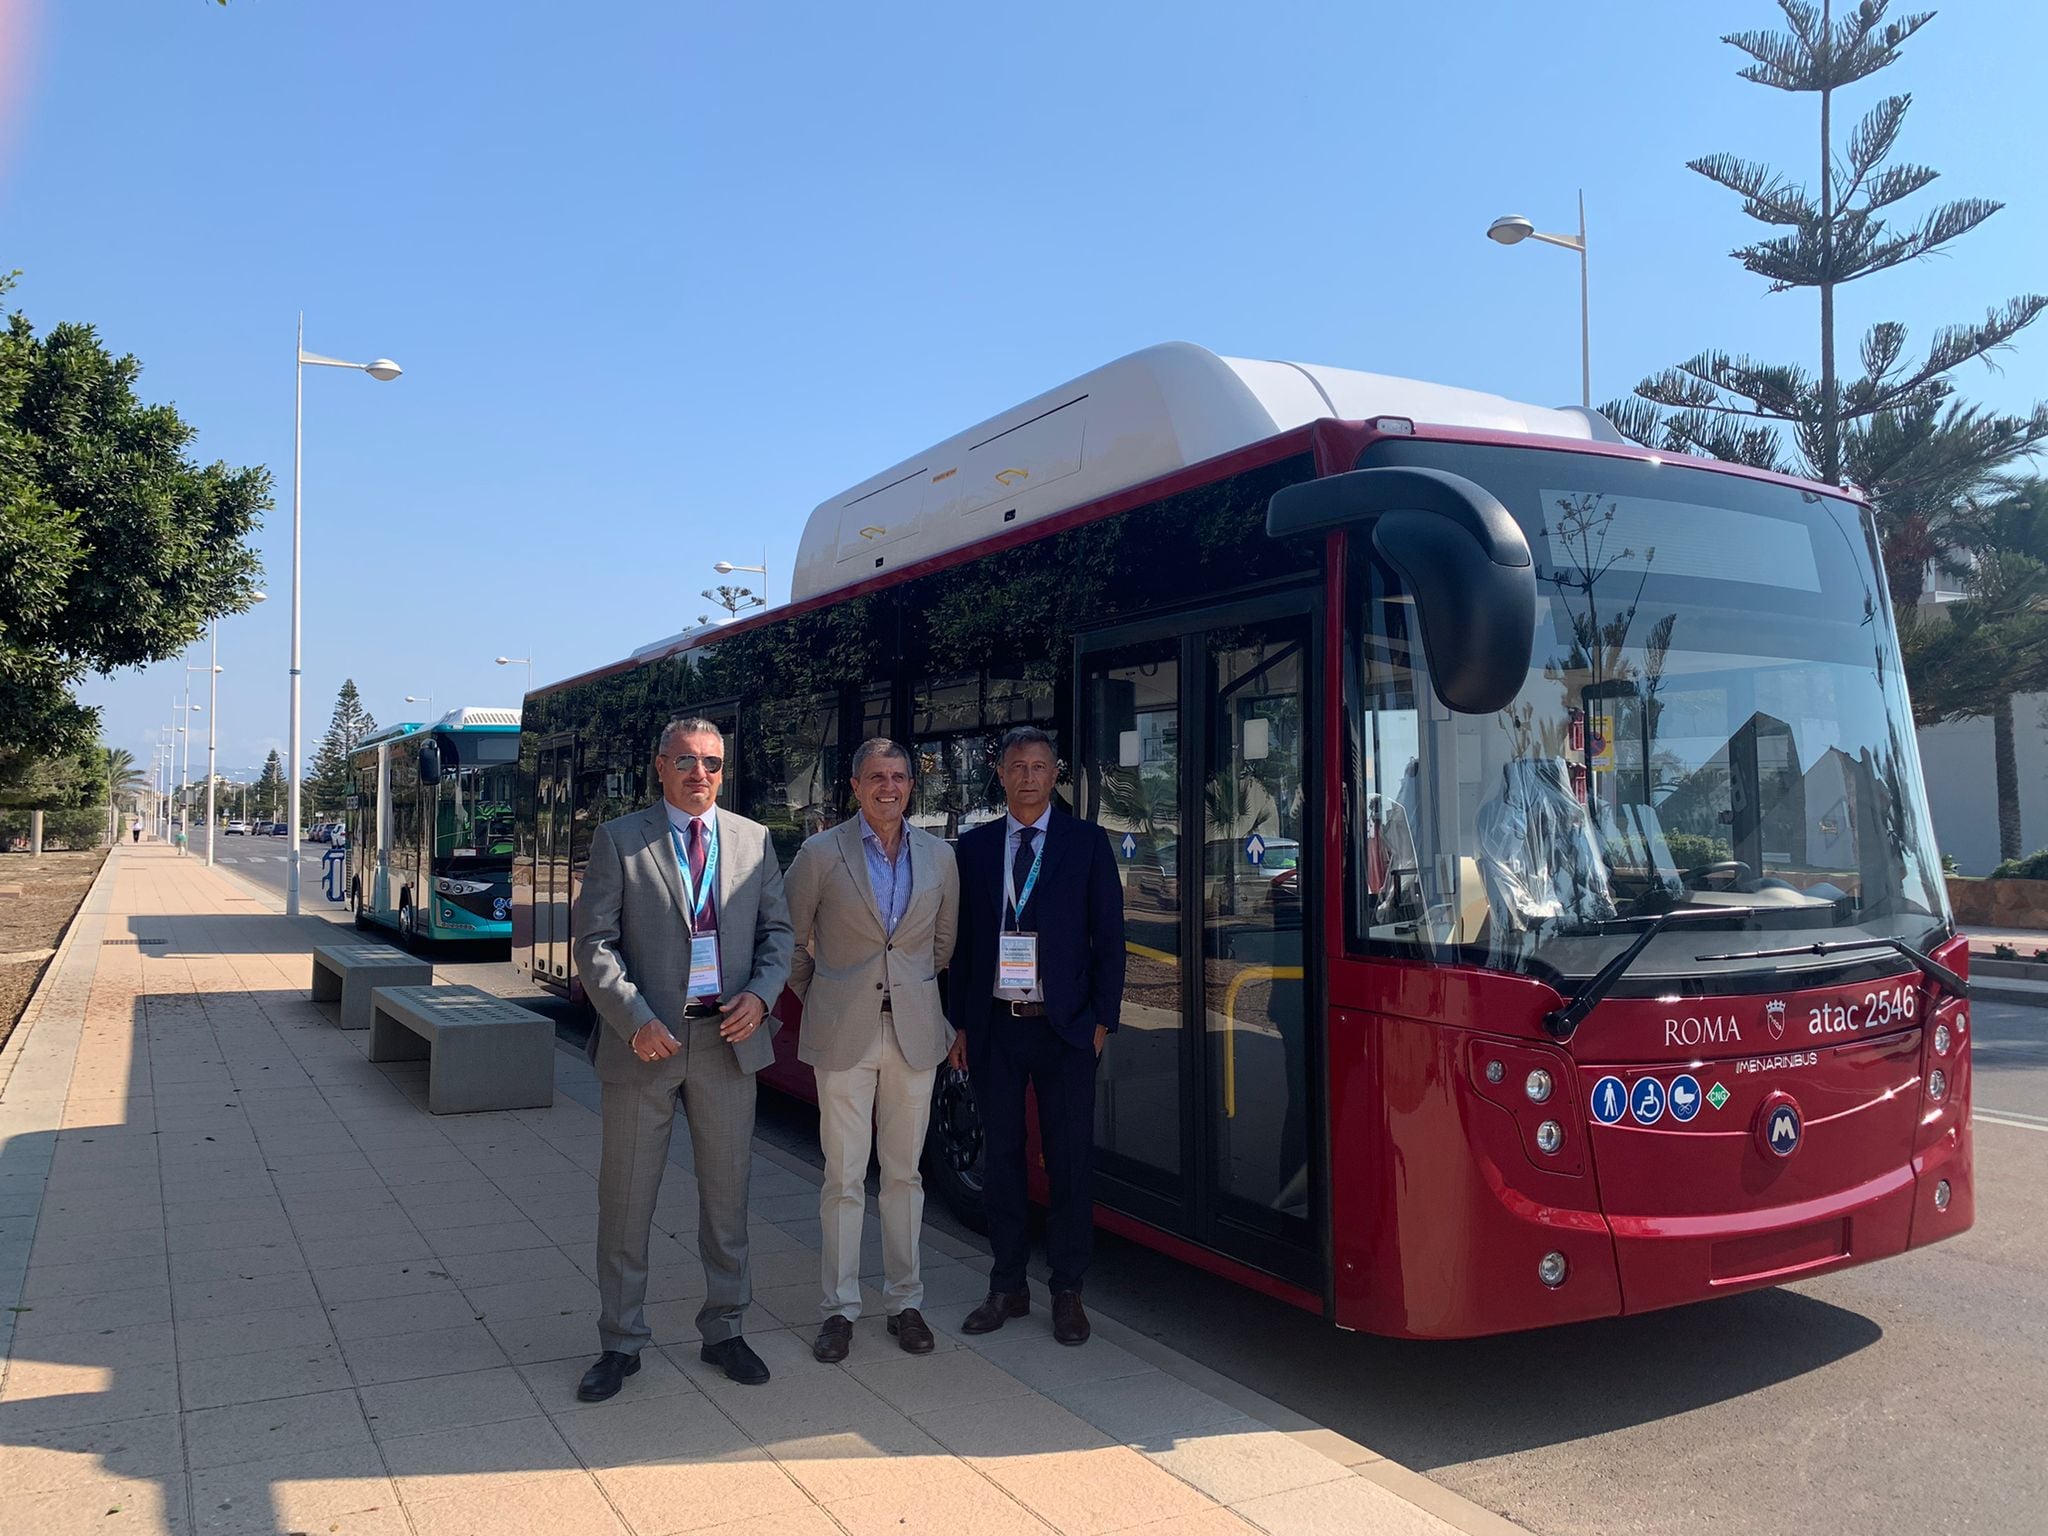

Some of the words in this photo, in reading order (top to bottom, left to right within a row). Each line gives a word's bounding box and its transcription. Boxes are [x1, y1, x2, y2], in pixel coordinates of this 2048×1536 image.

[1808, 1002, 1859, 1035] atac
[1864, 984, 1915, 1029] 2546
[1664, 1014, 1742, 1046] ROMA
[1710, 1090, 1727, 1102] CNG
[1771, 1115, 1796, 1142] M
